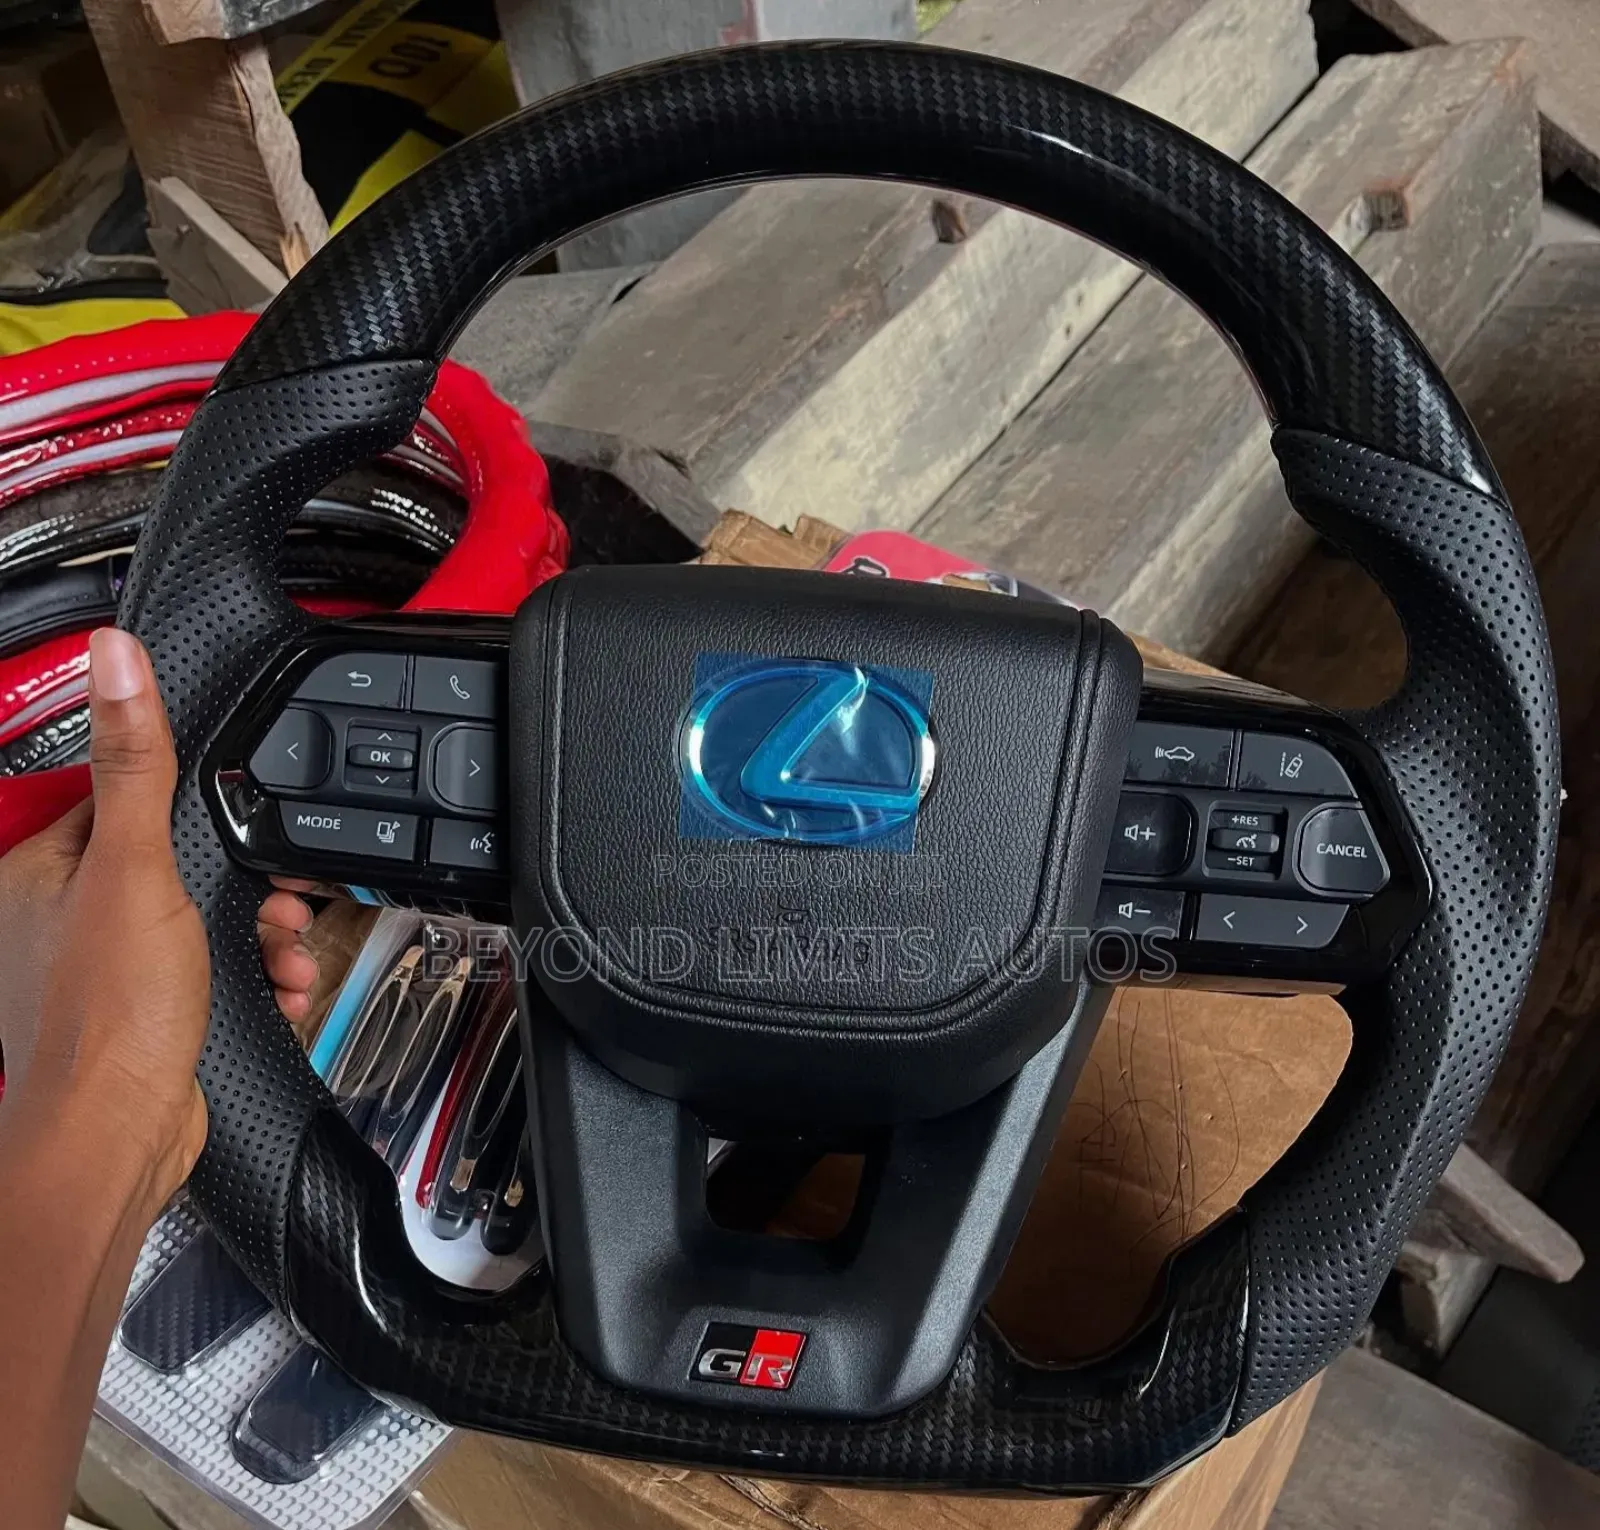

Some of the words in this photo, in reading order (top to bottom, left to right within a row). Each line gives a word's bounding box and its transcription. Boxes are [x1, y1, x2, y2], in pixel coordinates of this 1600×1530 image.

[370, 750, 391, 763] OK
[297, 815, 342, 830] MODE
[1316, 842, 1368, 858] CANCEL
[698, 1348, 794, 1387] GR
